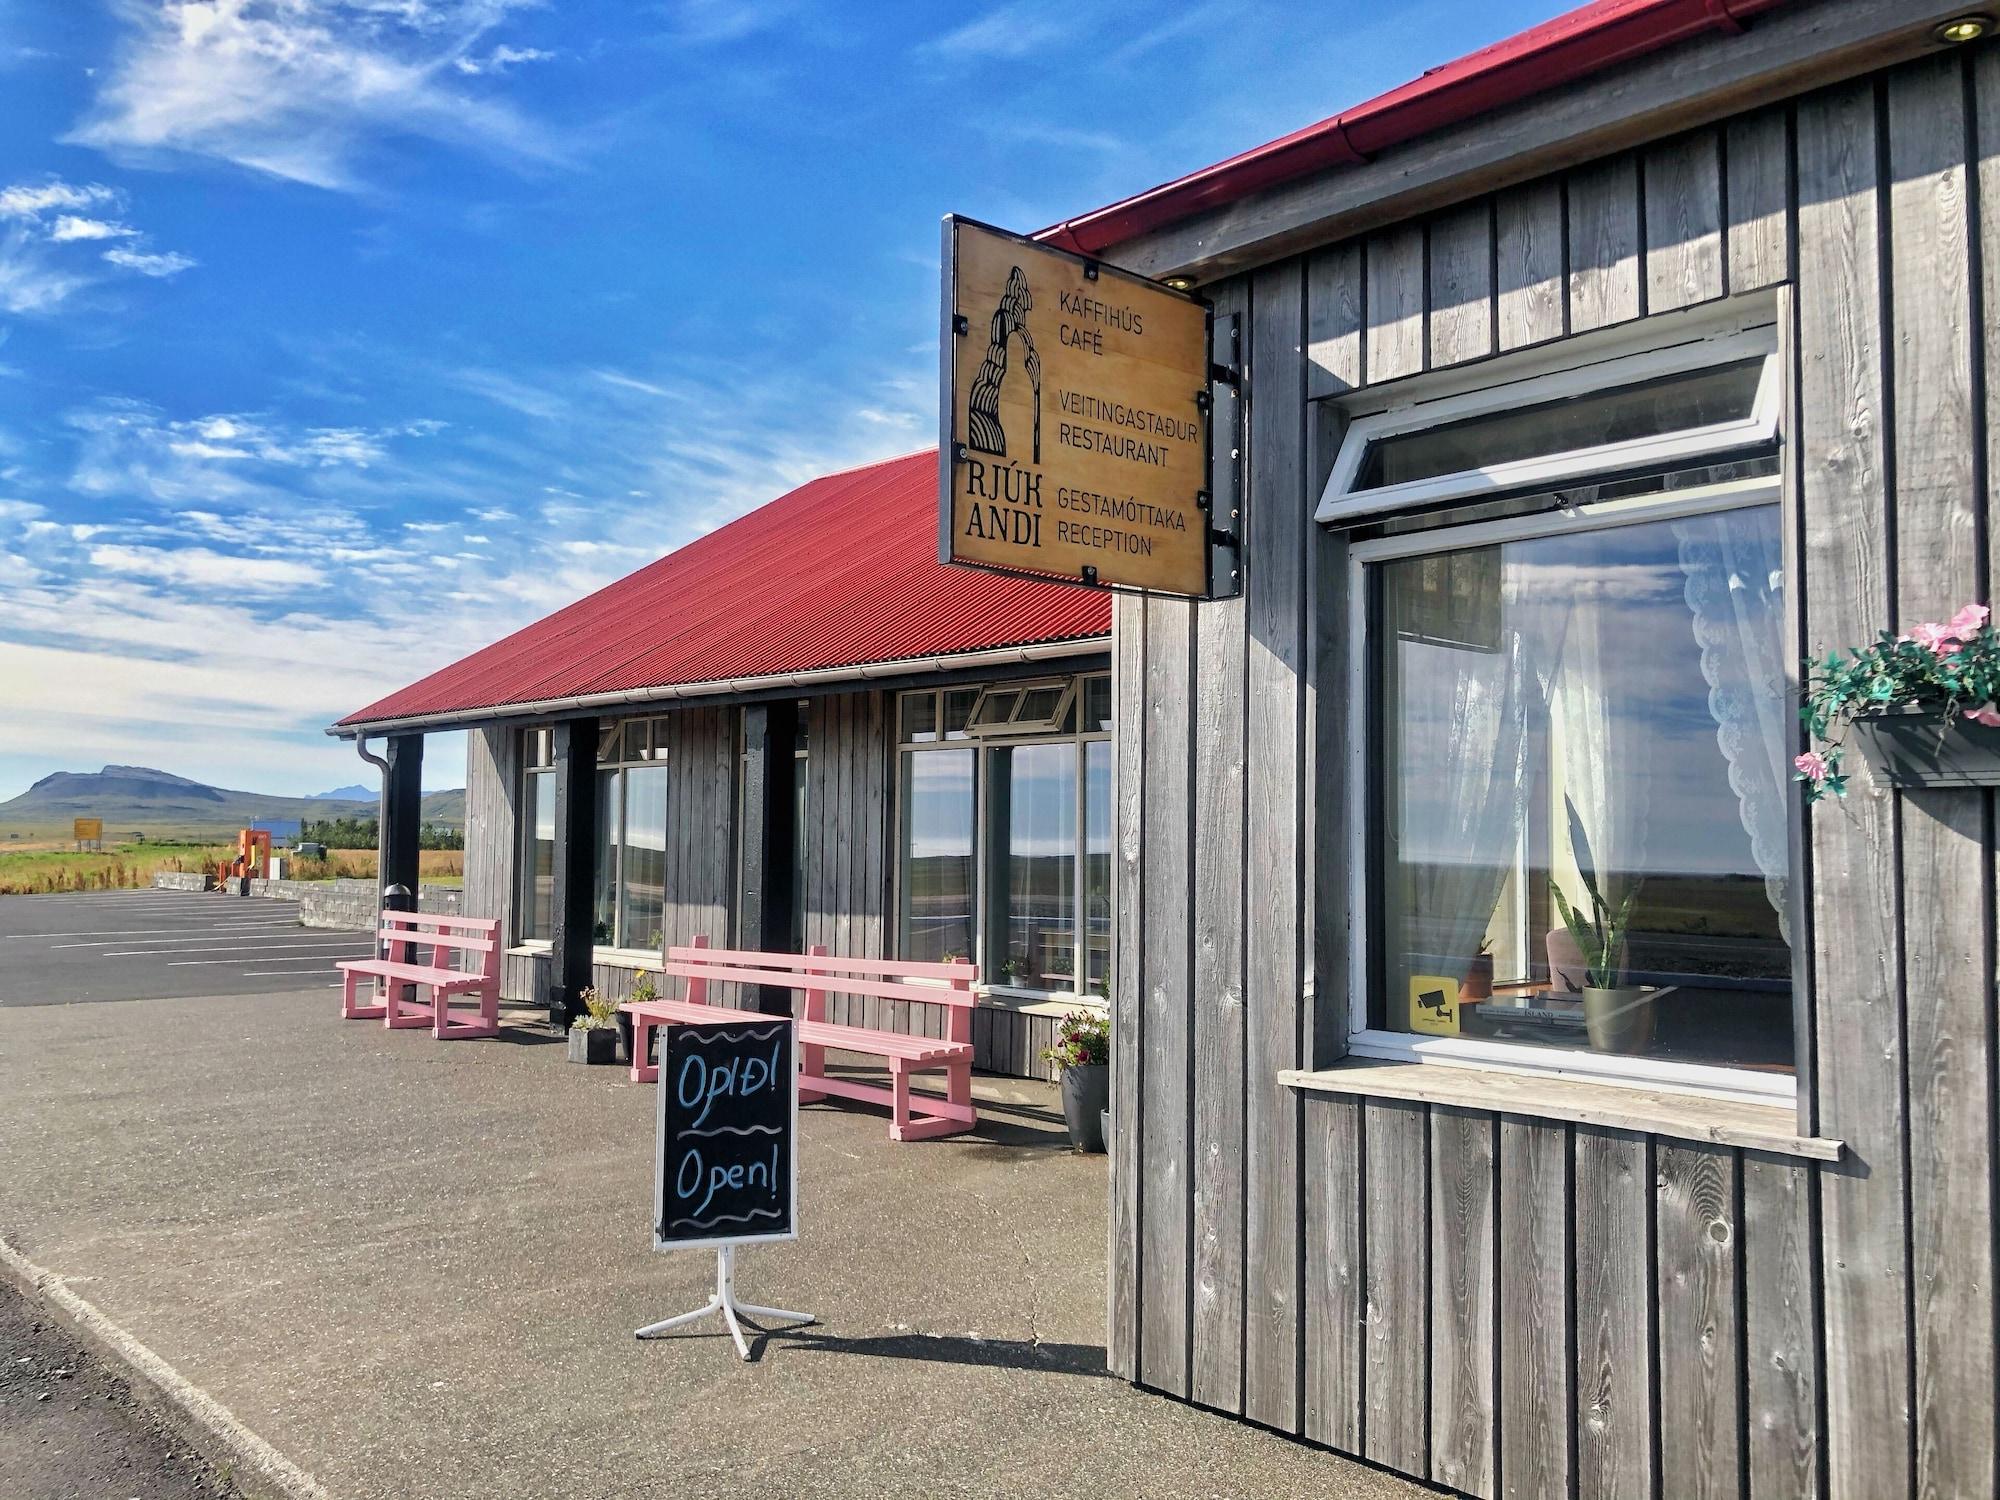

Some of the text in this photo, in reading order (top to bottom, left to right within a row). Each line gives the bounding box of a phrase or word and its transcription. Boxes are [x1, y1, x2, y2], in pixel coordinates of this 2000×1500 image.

[1060, 291, 1143, 335] KAFFIHÚS
[1060, 325, 1103, 356] CAFÉ
[1059, 389, 1198, 444] VEITINGASTAÐUR
[1060, 423, 1169, 468] RESTAURANT
[966, 459, 1043, 508] RJÚK
[965, 502, 1042, 548] ANDI
[1058, 487, 1186, 532] GESTAMÓTTAKA
[1058, 520, 1151, 557] RECEPTION
[677, 1143, 780, 1217] Open!
